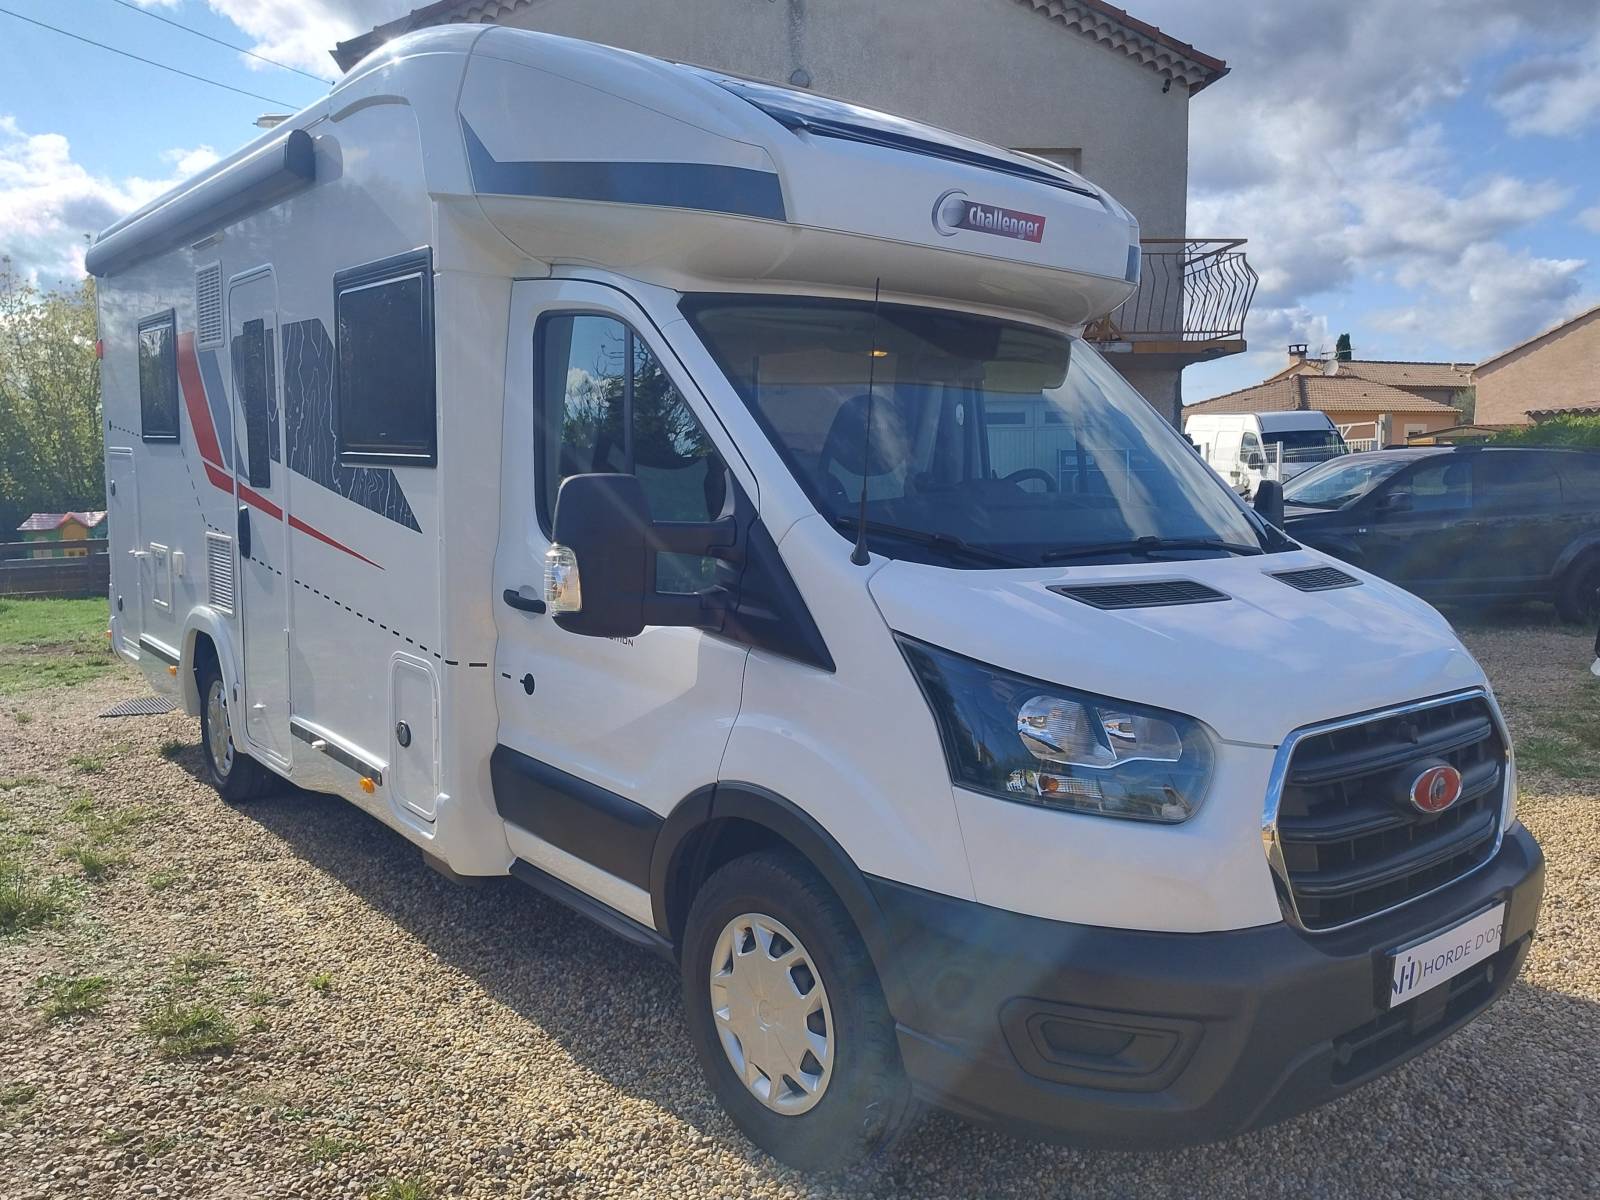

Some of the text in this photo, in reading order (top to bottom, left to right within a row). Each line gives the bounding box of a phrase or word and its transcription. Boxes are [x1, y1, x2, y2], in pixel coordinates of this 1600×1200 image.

[969, 206, 1039, 238] Challenger
[1423, 940, 1472, 977] HORDE
[1475, 924, 1504, 950] D'OR
